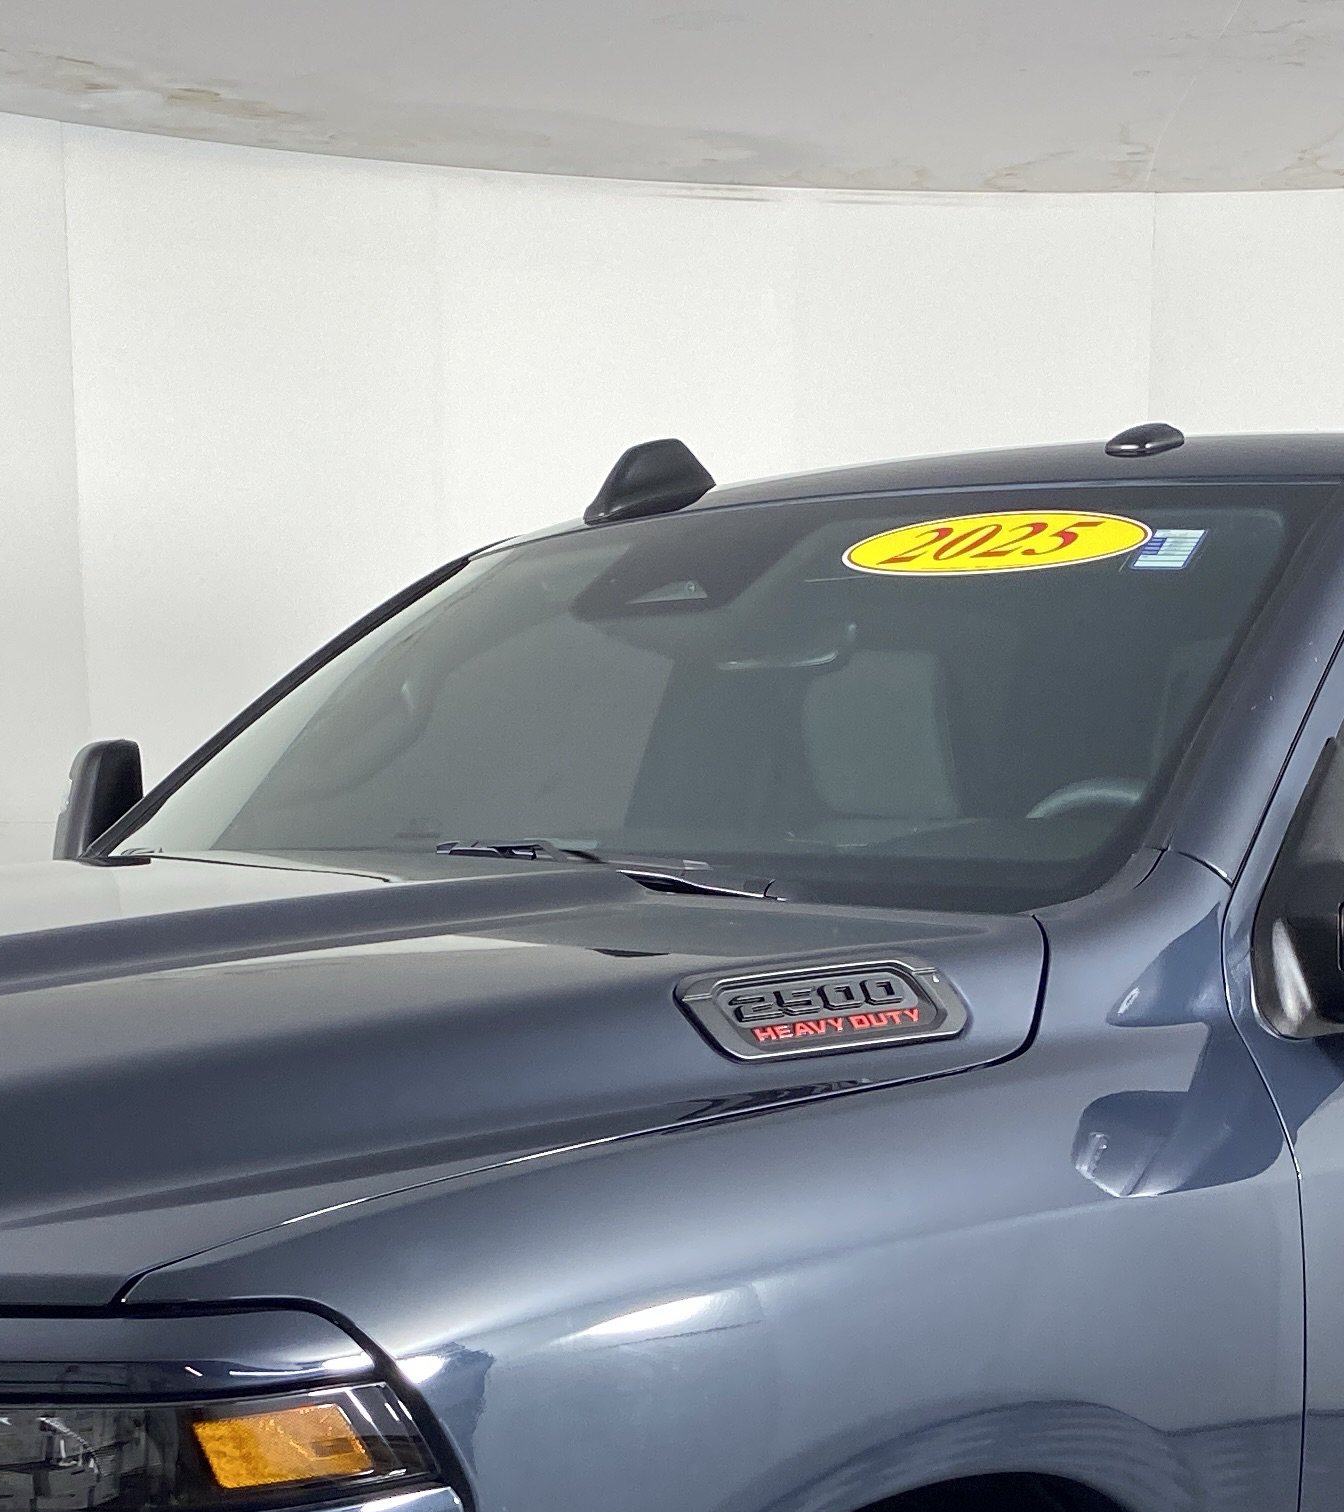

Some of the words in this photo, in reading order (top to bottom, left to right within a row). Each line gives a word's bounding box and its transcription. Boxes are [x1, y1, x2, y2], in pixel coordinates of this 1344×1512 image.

[877, 521, 1105, 565] 2025
[729, 979, 904, 1022] 2500
[752, 1017, 844, 1042] HEAVY
[848, 1008, 921, 1031] DUTY
